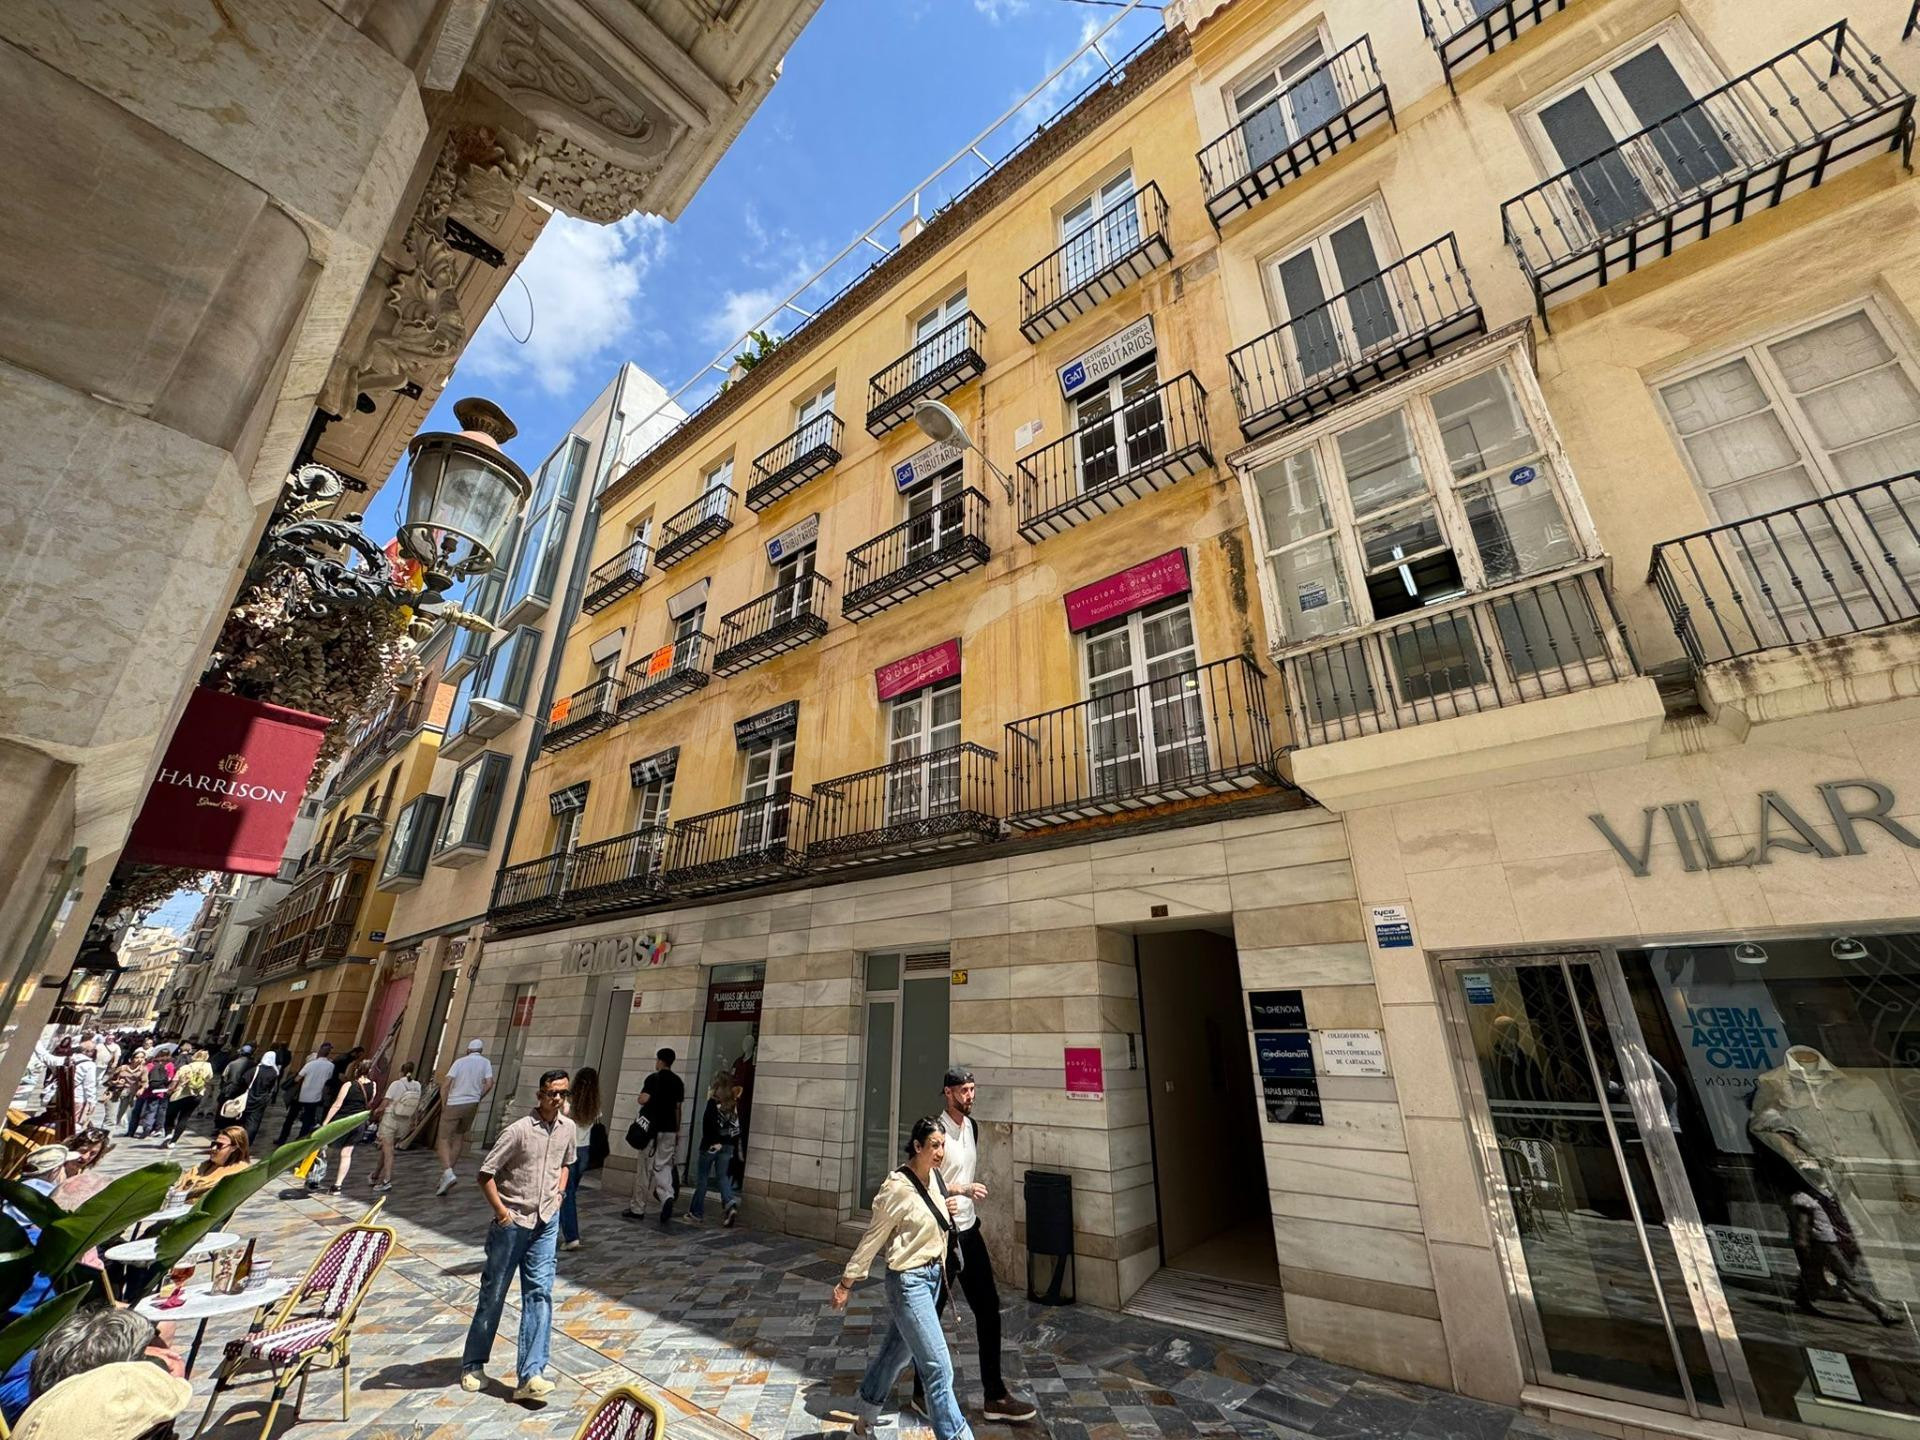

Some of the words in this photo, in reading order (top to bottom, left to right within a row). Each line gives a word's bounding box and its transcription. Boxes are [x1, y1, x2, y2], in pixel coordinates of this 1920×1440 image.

[1120, 322, 1149, 343] ASESORES
[1086, 331, 1153, 379] TRIBUTARIOS
[1064, 366, 1083, 385] GAT
[1513, 470, 1530, 481] ADT
[158, 768, 287, 804] HARRISON
[1588, 778, 1920, 877] VILAR
[1265, 1005, 1301, 1014] GHENOVA
